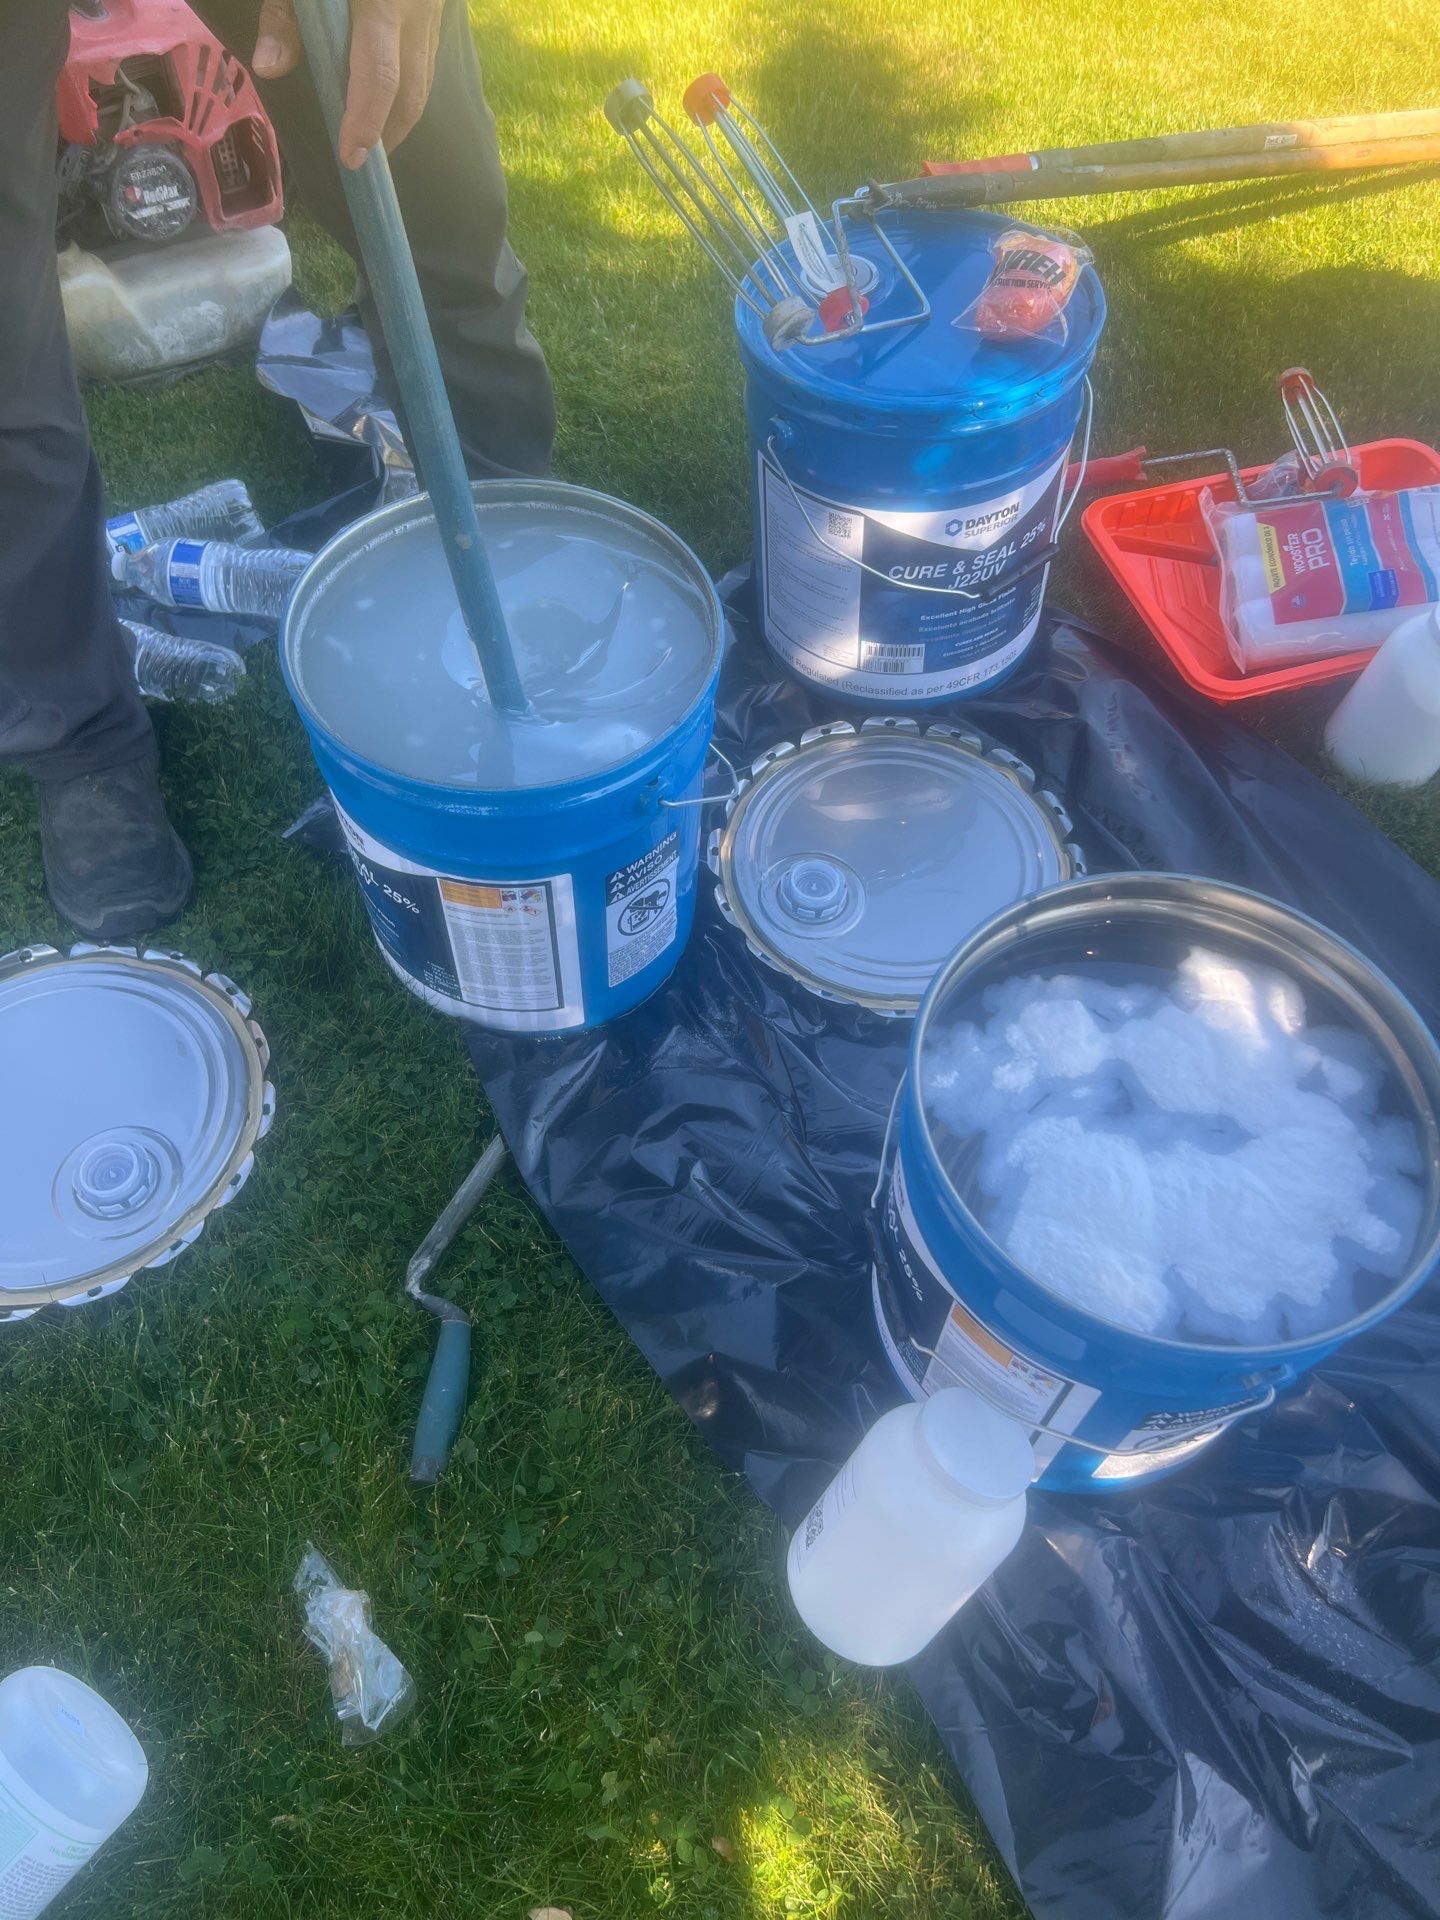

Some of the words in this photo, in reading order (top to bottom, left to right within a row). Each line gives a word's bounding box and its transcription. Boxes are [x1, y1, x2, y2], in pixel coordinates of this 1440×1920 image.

[964, 514, 1018, 539] SUPERIOR
[965, 502, 1020, 529] DAYTON
[888, 563, 948, 580] CURE
[952, 560, 966, 575] &
[971, 541, 1017, 571] SEAL
[1020, 520, 1046, 550] 25%
[1287, 533, 1306, 575] WOOSTER
[1301, 527, 1330, 571] PRO
[948, 560, 1007, 590] J22UV
[920, 610, 957, 621] Excellent
[959, 606, 976, 615] High
[795, 657, 839, 687] Regulated
[841, 679, 908, 697] (Reclassified
[911, 687, 924, 696] as
[926, 684, 943, 695] per
[946, 672, 981, 690] 49CFR
[626, 831, 677, 874] WARNING
[626, 850, 678, 895] AVERTISSEMENT
[627, 854, 663, 885] AVISO
[383, 884, 420, 914] 25%
[899, 1249, 923, 1302] 25%
